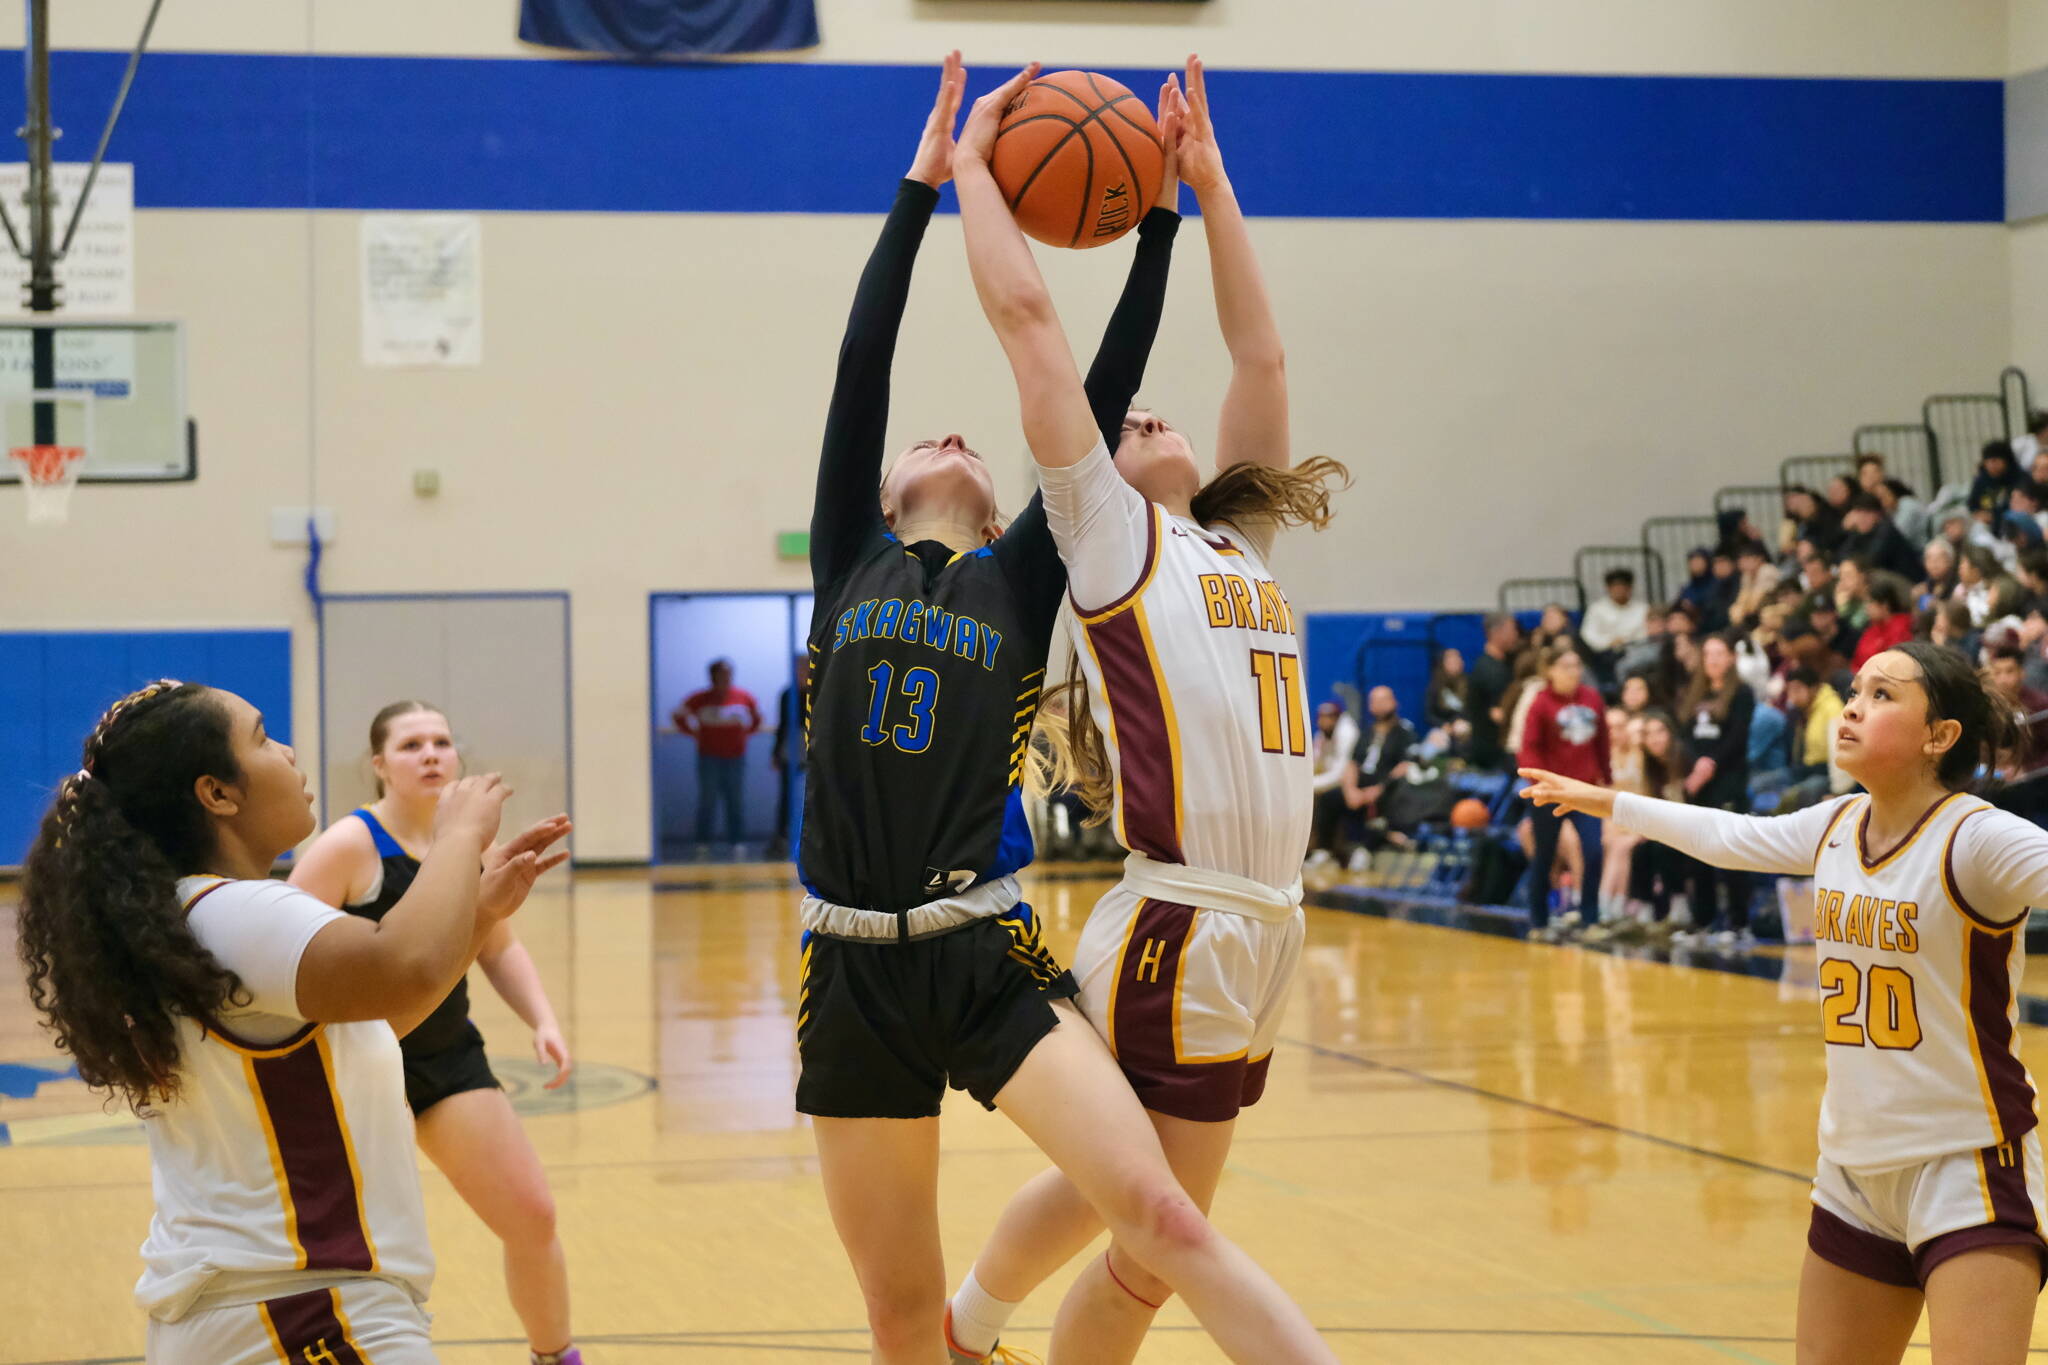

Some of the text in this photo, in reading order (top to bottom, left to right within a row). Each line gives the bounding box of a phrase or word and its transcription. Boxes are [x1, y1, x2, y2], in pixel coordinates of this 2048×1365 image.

[833, 598, 1002, 671] SKAGWAY
[861, 660, 940, 753] 13
[1250, 649, 1305, 757] 11
[1136, 938, 1166, 983] H
[1816, 888, 1919, 953] BRAVES
[1820, 957, 1922, 1051] 20
